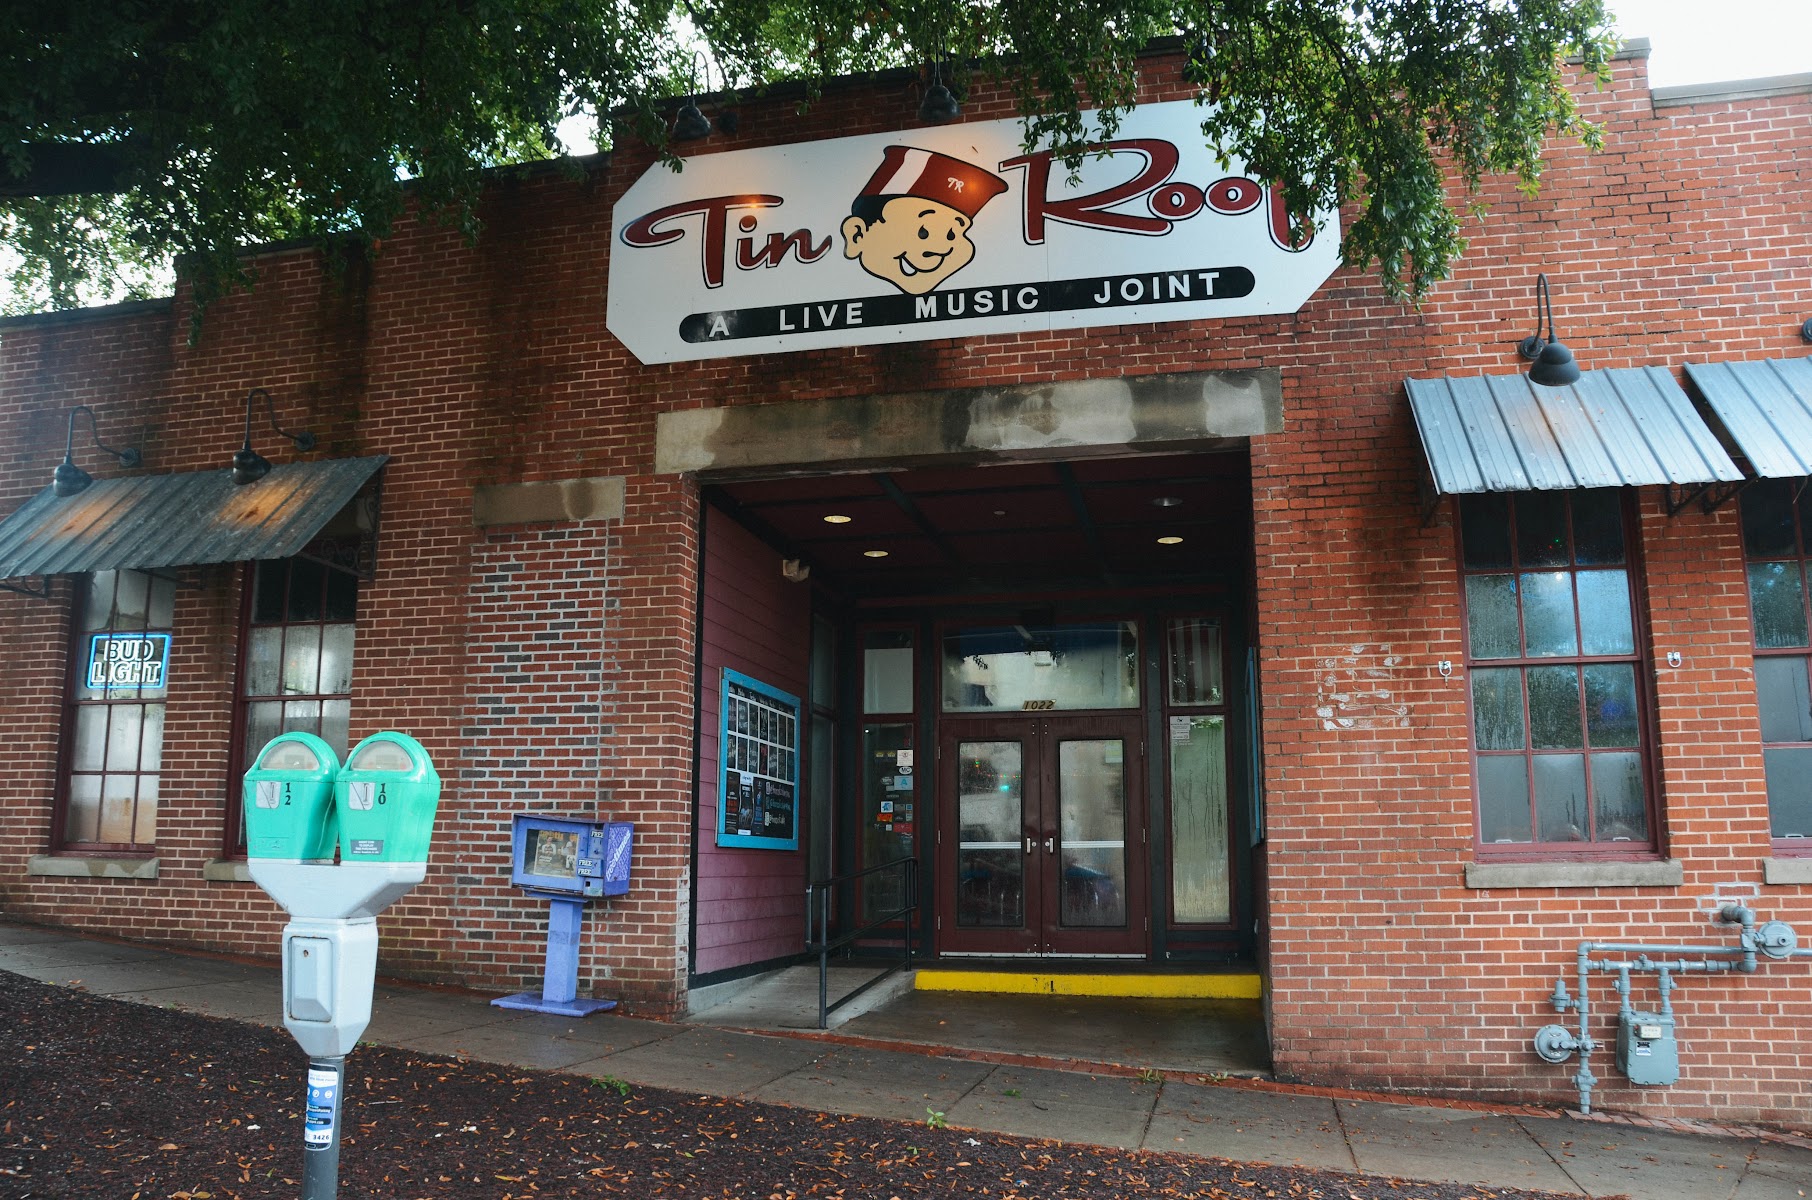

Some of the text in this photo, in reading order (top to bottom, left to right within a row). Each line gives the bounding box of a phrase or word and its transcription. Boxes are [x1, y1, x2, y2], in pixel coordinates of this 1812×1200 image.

[620, 194, 832, 289] Tin
[708, 272, 1221, 338] A LIVE MUSIC JOINT
[103, 640, 155, 662] BUD
[91, 661, 162, 683] LIGHT
[1023, 700, 1054, 710] 1022
